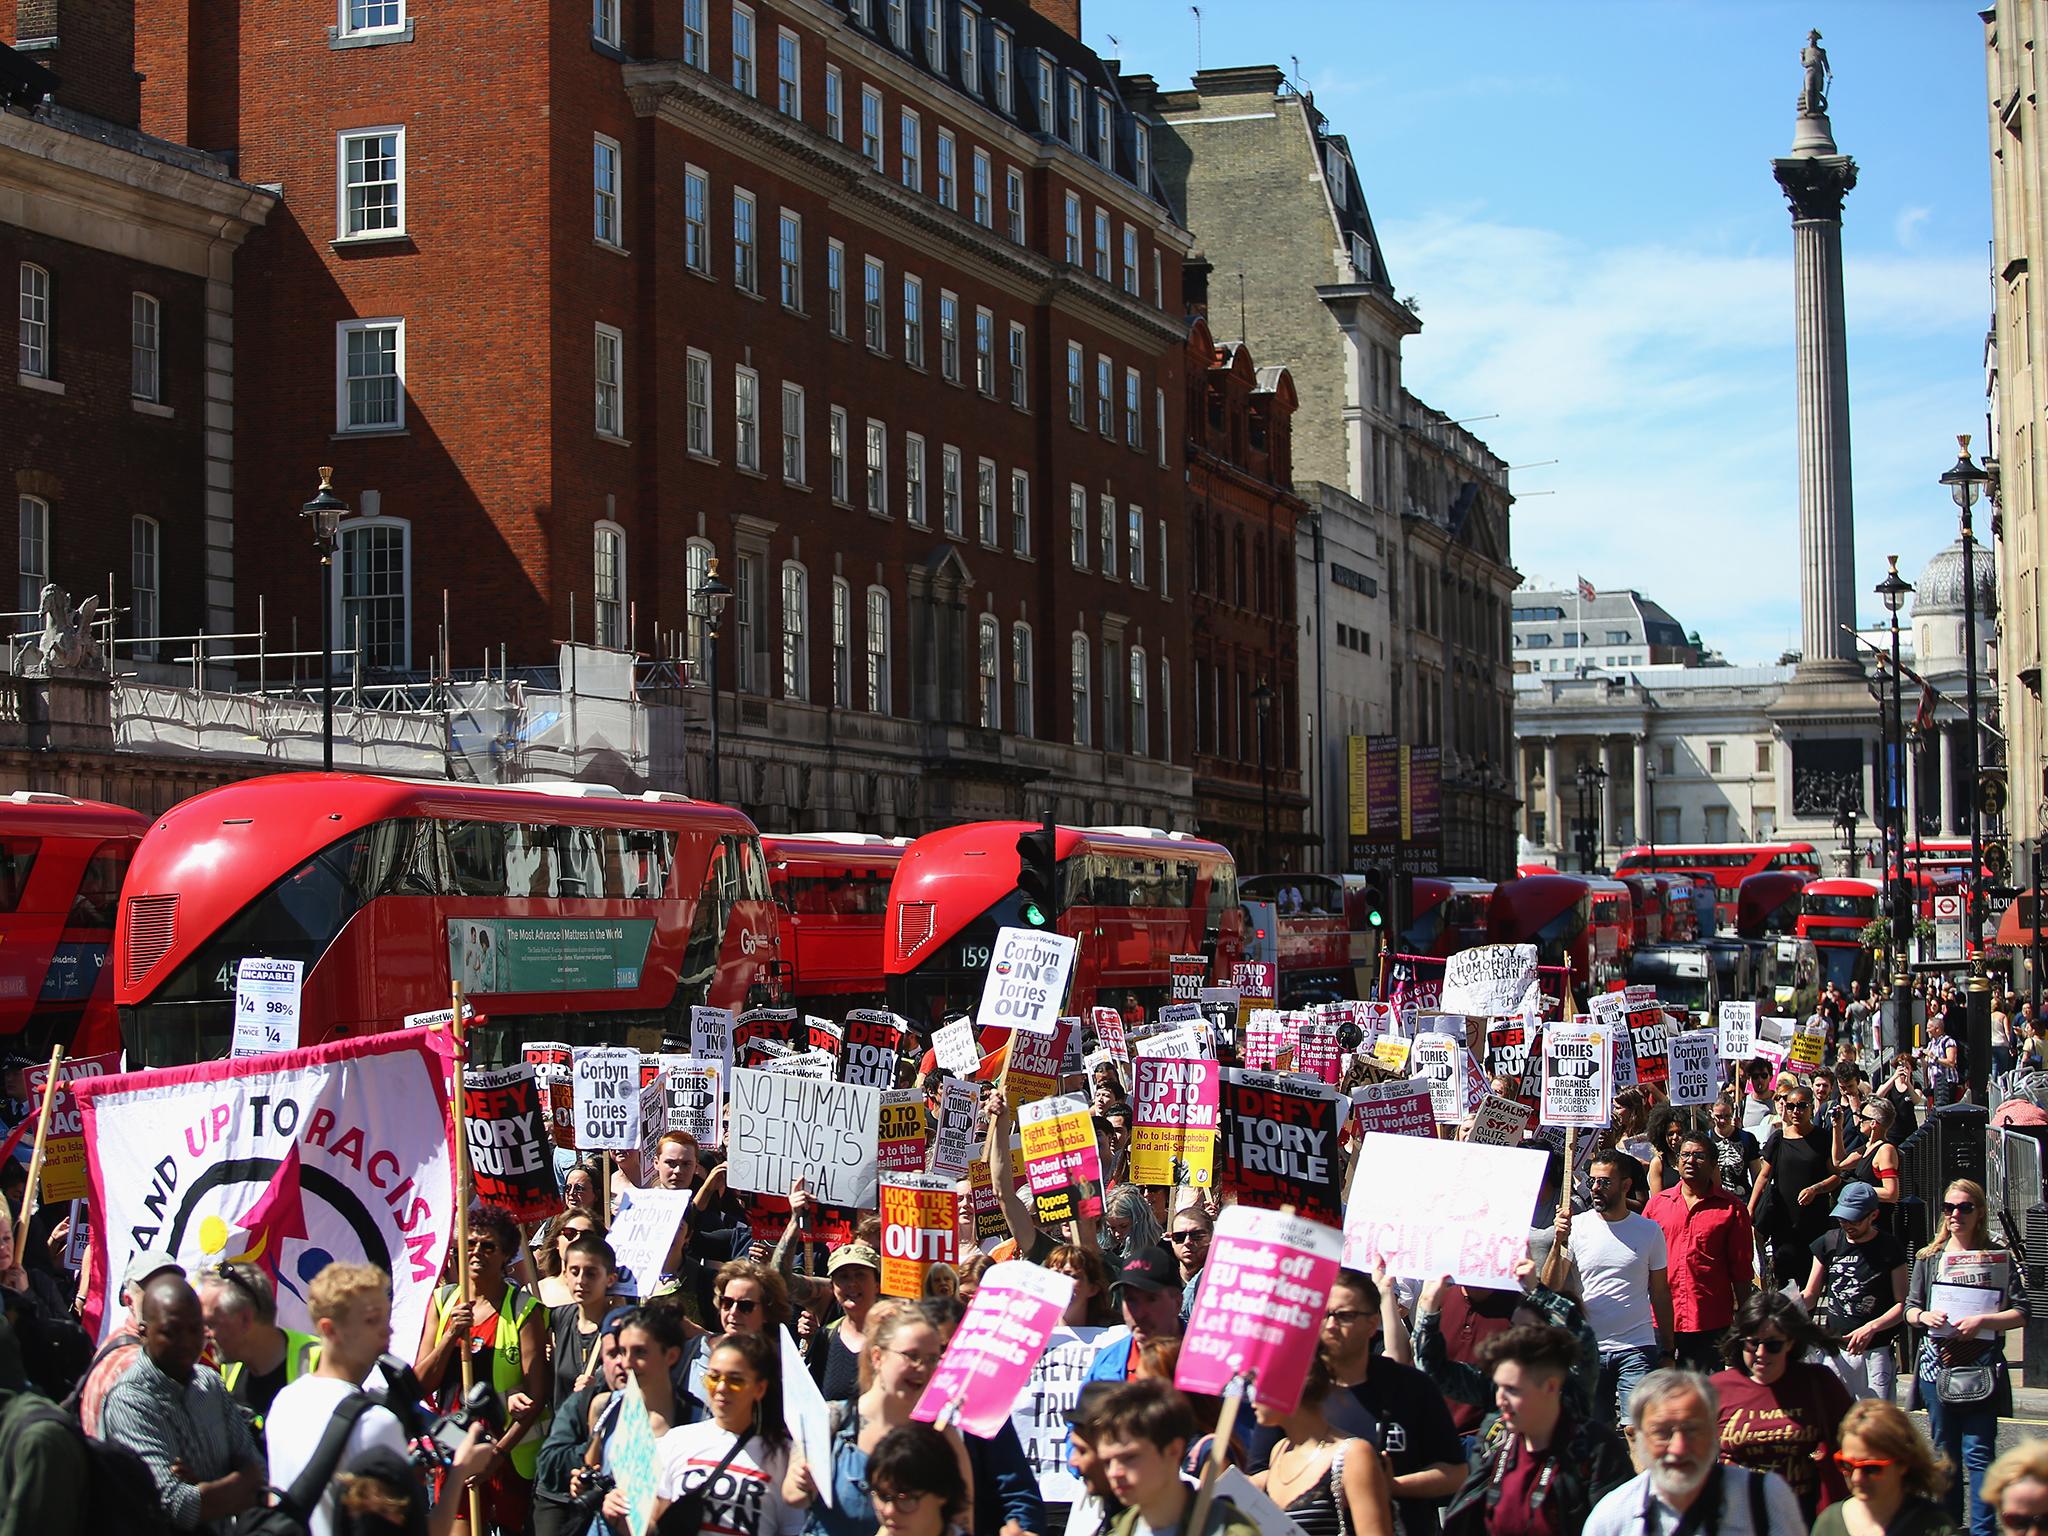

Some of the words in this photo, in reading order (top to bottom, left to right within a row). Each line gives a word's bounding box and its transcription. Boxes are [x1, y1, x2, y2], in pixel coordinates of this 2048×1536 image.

[1353, 844, 1377, 854] KISS
[1381, 843, 1396, 854] ME
[1423, 848, 1437, 858] ME
[507, 928, 518, 940] The
[519, 929, 534, 940] Most
[564, 929, 588, 941] Mattress
[595, 928, 605, 940] the
[1037, 936, 1063, 948] Worker
[962, 946, 990, 968] 159
[1004, 940, 1060, 967] Corbyn
[243, 962, 274, 971] WRONG
[275, 963, 295, 972] AND
[1015, 962, 1042, 981] IN
[1173, 963, 1205, 975] DEFY
[1233, 964, 1267, 975] STAND
[242, 971, 293, 981] INCAPABLE
[617, 971, 638, 985] SIMBA
[1173, 975, 1205, 988] TORY
[1232, 975, 1246, 985] UP
[1249, 975, 1264, 986] TO
[999, 978, 1047, 1003] Tories
[1173, 987, 1203, 999] RULE
[266, 1002, 294, 1016] 98%
[994, 998, 1045, 1021] OUT
[1597, 1003, 1620, 1014] TORIES
[1724, 1008, 1751, 1023] Corbyn
[412, 1013, 442, 1026] Socialist
[737, 1014, 763, 1025] Socialist
[763, 1011, 789, 1020] Worker
[855, 1011, 889, 1024] Socialist
[238, 1028, 259, 1037] TWICE
[697, 1018, 726, 1035] Corbyn
[936, 1021, 969, 1044] Strong
[1731, 1020, 1744, 1031] IN
[706, 1035, 718, 1050] IN
[1301, 1035, 1322, 1044] Hands
[1323, 1036, 1334, 1044] off
[1725, 1031, 1749, 1042] Tories
[1032, 1042, 1051, 1057] TO
[1307, 1050, 1337, 1060] students
[1554, 1044, 1593, 1057] TORIES
[1674, 1046, 1708, 1060] Corbyn
[1726, 1042, 1748, 1053] OUT
[1301, 1058, 1312, 1066] Let
[1313, 1058, 1330, 1067] them
[1420, 1050, 1448, 1062] TORIES
[580, 1061, 628, 1083] Corbyn
[1010, 1053, 1059, 1076] RACISM
[1139, 1061, 1207, 1083] STAND
[1558, 1059, 1590, 1076] OUT!
[1684, 1059, 1699, 1071] IN
[488, 1070, 522, 1087] Worker
[793, 1069, 823, 1079] Worker
[1677, 1072, 1708, 1085] Tories
[594, 1082, 615, 1099] IN
[671, 1077, 708, 1090] TORIES
[1241, 1073, 1284, 1091] Socialist
[1284, 1082, 1322, 1098] Worker
[1679, 1084, 1708, 1098] OUT
[464, 1082, 529, 1118] DEFY
[674, 1091, 704, 1107] OUT!
[1138, 1082, 1169, 1102] UP
[1173, 1083, 1200, 1104] TO
[1574, 1087, 1600, 1098] RESIST
[736, 1074, 772, 1114] NO
[782, 1079, 871, 1133] HUMAN
[948, 1097, 972, 1112] TORIES
[1237, 1087, 1326, 1128] DEFY
[1550, 1097, 1562, 1105] FOR
[1564, 1097, 1597, 1105] CORBYN'S
[584, 1100, 627, 1119] Tories
[897, 1107, 916, 1121] TO
[1137, 1102, 1213, 1125] RACISM
[1359, 1103, 1399, 1121] Hands
[1401, 1099, 1419, 1113] off
[1483, 1108, 1505, 1121] HERE
[1558, 1105, 1587, 1113] POLICIES
[689, 1118, 714, 1127] RESIST
[948, 1112, 967, 1129] OUT!
[1361, 1118, 1379, 1131] EU
[1382, 1112, 1432, 1129] workers
[1486, 1118, 1519, 1134] STAY
[465, 1111, 534, 1147] TORY
[586, 1121, 627, 1138] OUT
[1023, 1127, 1046, 1143] Fight
[1237, 1115, 1328, 1157] TORY
[1477, 1126, 1507, 1141] QUITE
[739, 1114, 824, 1162] BEING
[831, 1129, 863, 1166] IS
[1137, 1130, 1149, 1140] No
[1150, 1131, 1160, 1140] to
[1160, 1130, 1209, 1144] Islamophobia
[886, 1146, 898, 1156] to
[899, 1145, 916, 1155] the
[1026, 1135, 1086, 1156] Islamophobia
[1136, 1141, 1152, 1151] and
[1153, 1141, 1206, 1153] anti-Semitism
[469, 1140, 544, 1175] RULE
[904, 1155, 922, 1164] ban
[1061, 1152, 1083, 1167] civil
[1242, 1143, 1329, 1184] RULE
[754, 1155, 844, 1202] ILLEGAL
[889, 1175, 919, 1188] Socialist
[919, 1180, 948, 1189] Worker
[184, 1103, 230, 1157] UP
[249, 1095, 299, 1137] TO
[305, 1107, 436, 1283] RACISM
[885, 1187, 917, 1207] KICK
[921, 1192, 952, 1209] THE
[1036, 1193, 1069, 1210] Oppose
[623, 1203, 672, 1225] Corbyn
[885, 1204, 953, 1229] TORIES
[1039, 1206, 1073, 1222] Prevent
[627, 1224, 653, 1242] IN
[885, 1224, 954, 1261] OUT!
[1344, 1220, 1445, 1271] FIGHT
[1214, 1240, 1279, 1271] Hands
[1279, 1255, 1316, 1281] off
[1977, 1271, 1992, 1283] THE
[1207, 1263, 1240, 1288] EU
[1240, 1271, 1324, 1308] workers
[1200, 1285, 1219, 1309] &
[1220, 1290, 1312, 1330] students
[1194, 1309, 1230, 1333] Let
[1231, 1313, 1285, 1345] them
[1188, 1333, 1233, 1362] stay
[1748, 1410, 1754, 1420] I
[1759, 1408, 1804, 1420] WANT
[1026, 1438, 1042, 1473] A
